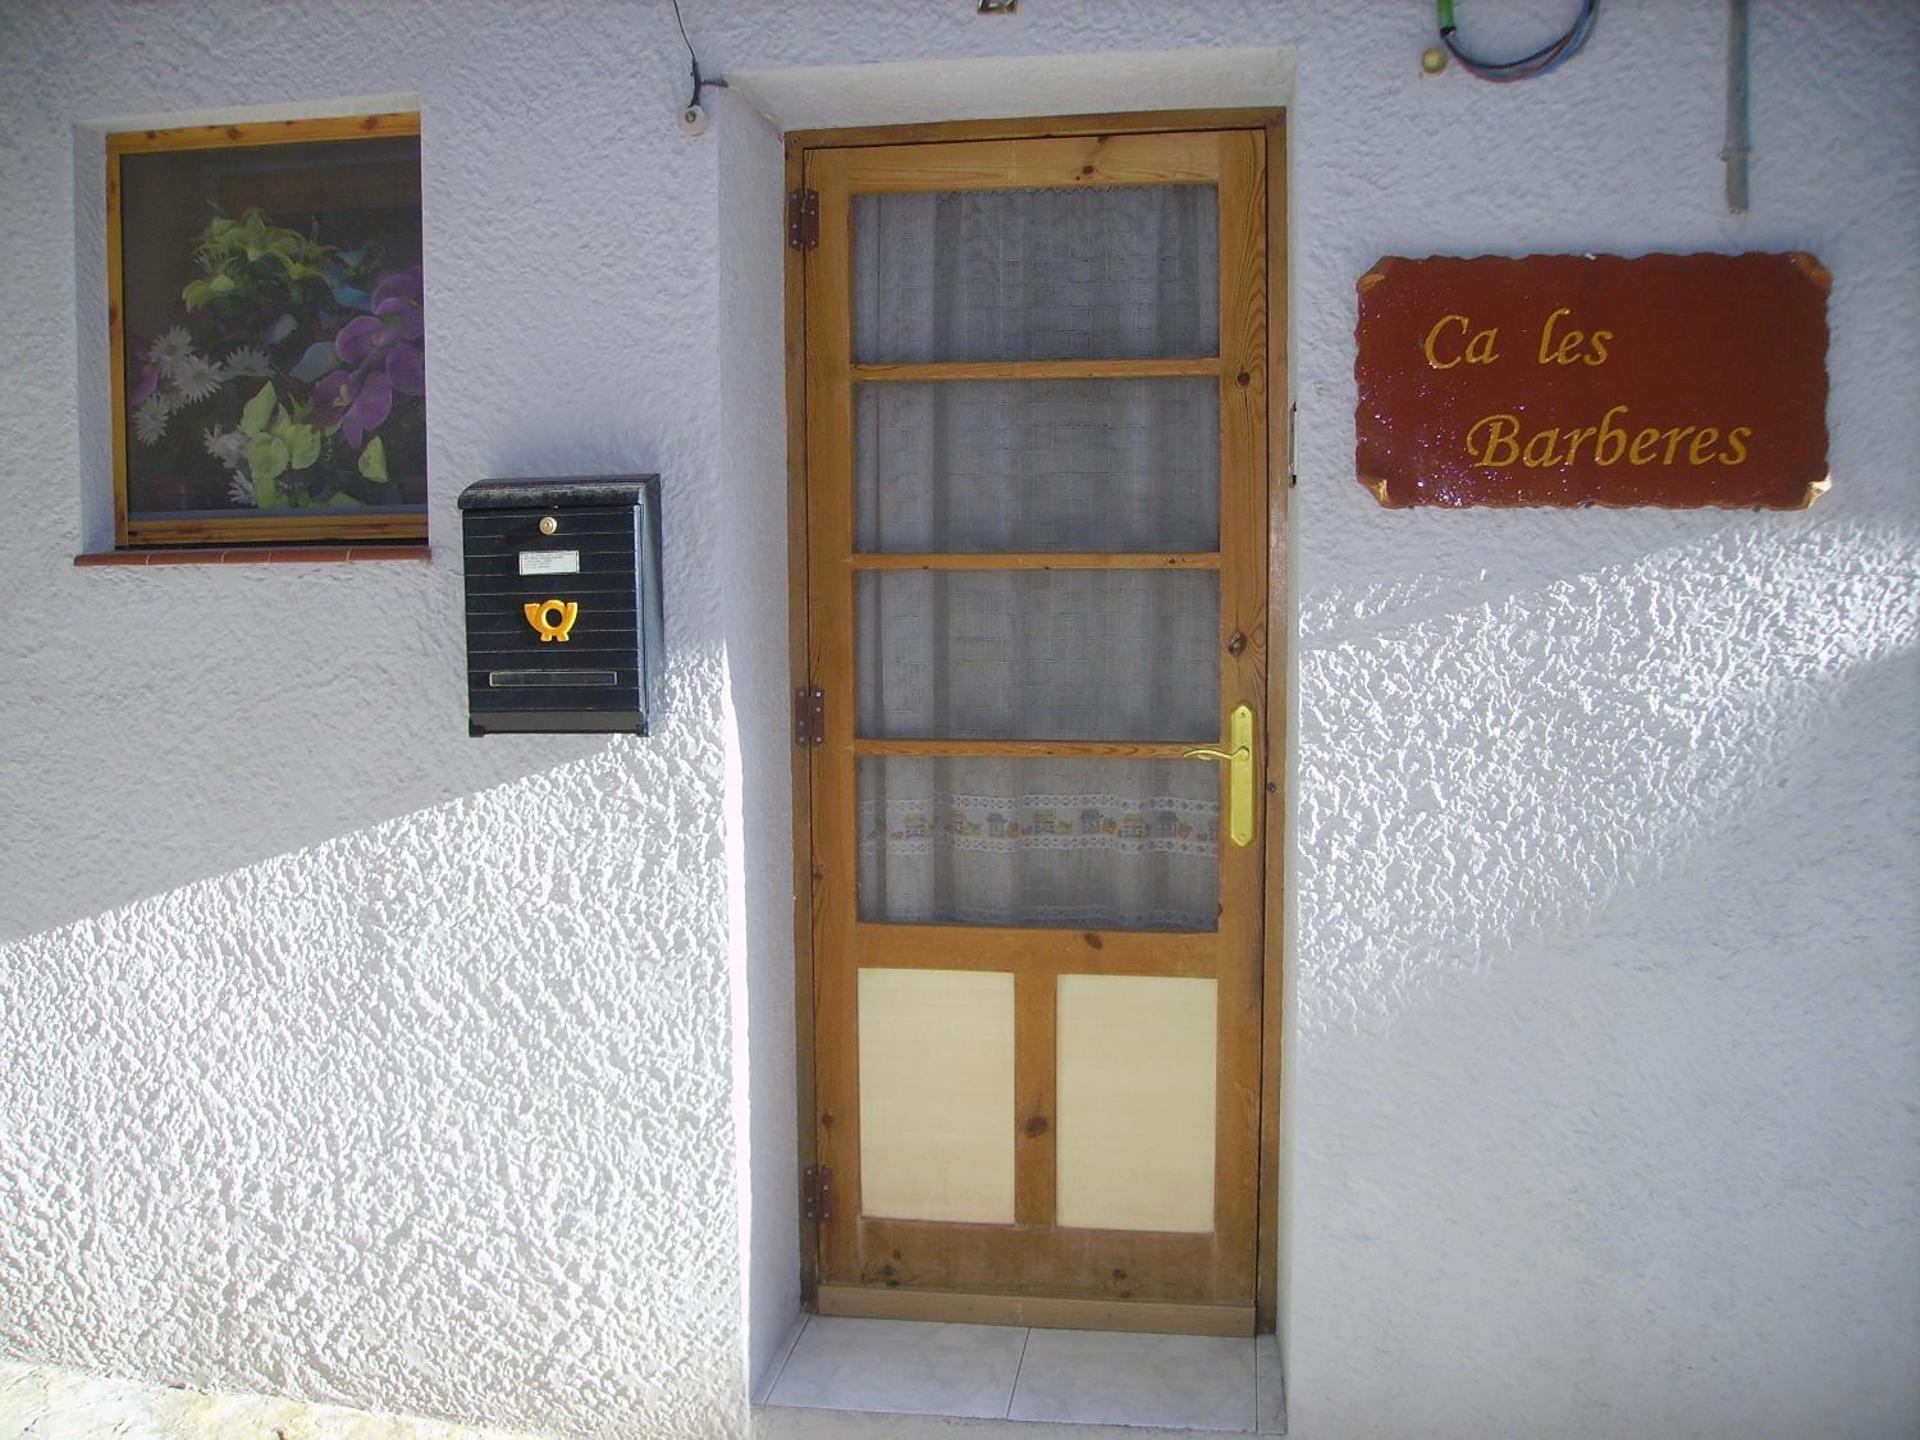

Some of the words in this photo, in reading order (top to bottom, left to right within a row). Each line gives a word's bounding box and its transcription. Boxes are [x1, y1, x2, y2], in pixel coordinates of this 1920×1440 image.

[1424, 314, 1499, 370] Ca
[1537, 307, 1614, 367] les
[1466, 404, 1754, 468] Barberes
